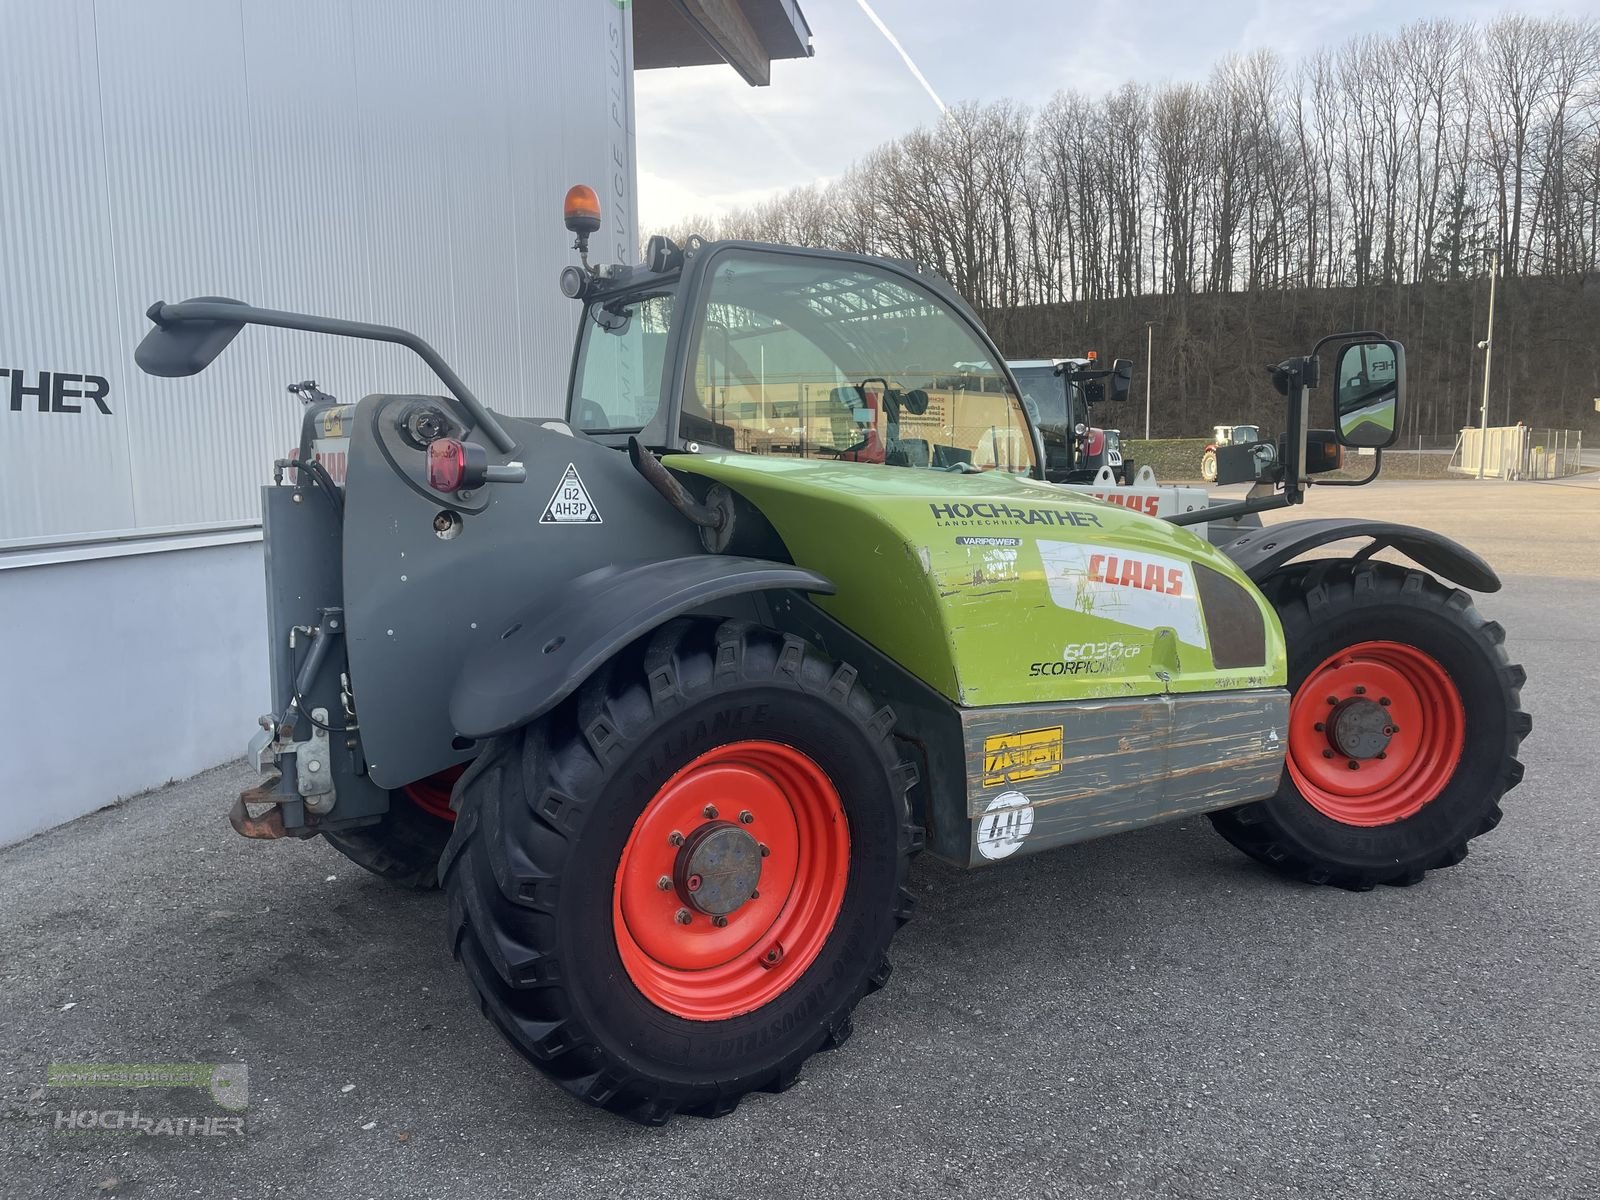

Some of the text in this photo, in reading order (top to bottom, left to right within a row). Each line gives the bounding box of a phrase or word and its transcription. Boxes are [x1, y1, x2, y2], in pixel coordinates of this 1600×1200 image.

[608, 22, 622, 128] PLUS
[613, 144, 627, 267] RVICE
[555, 503, 587, 515] AH3P
[929, 503, 1103, 528] HOCHRATHER
[937, 519, 1021, 527] LANDTECHNIK
[963, 537, 1016, 546] VARIPOWER
[1088, 554, 1183, 596] CLAAS
[631, 703, 771, 794] ALLIANCE
